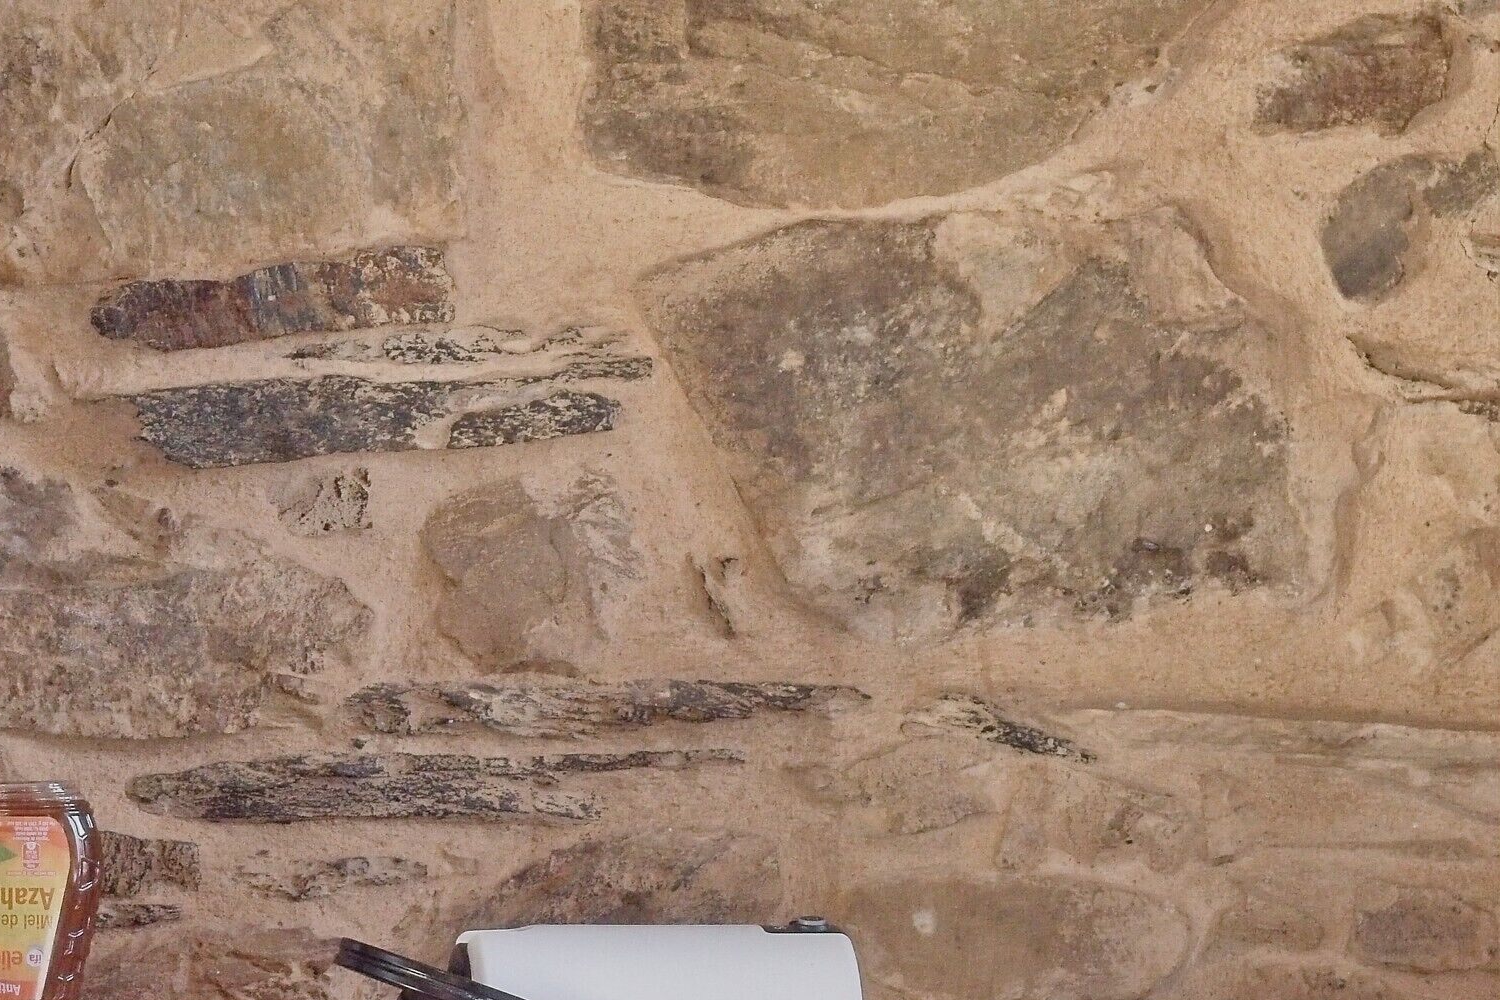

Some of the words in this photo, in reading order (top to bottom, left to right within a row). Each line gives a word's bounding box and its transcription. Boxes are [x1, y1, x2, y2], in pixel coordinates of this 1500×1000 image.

[1, 914, 18, 929] de
[24, 914, 52, 929] Miel
[29, 954, 42, 964] ifa
